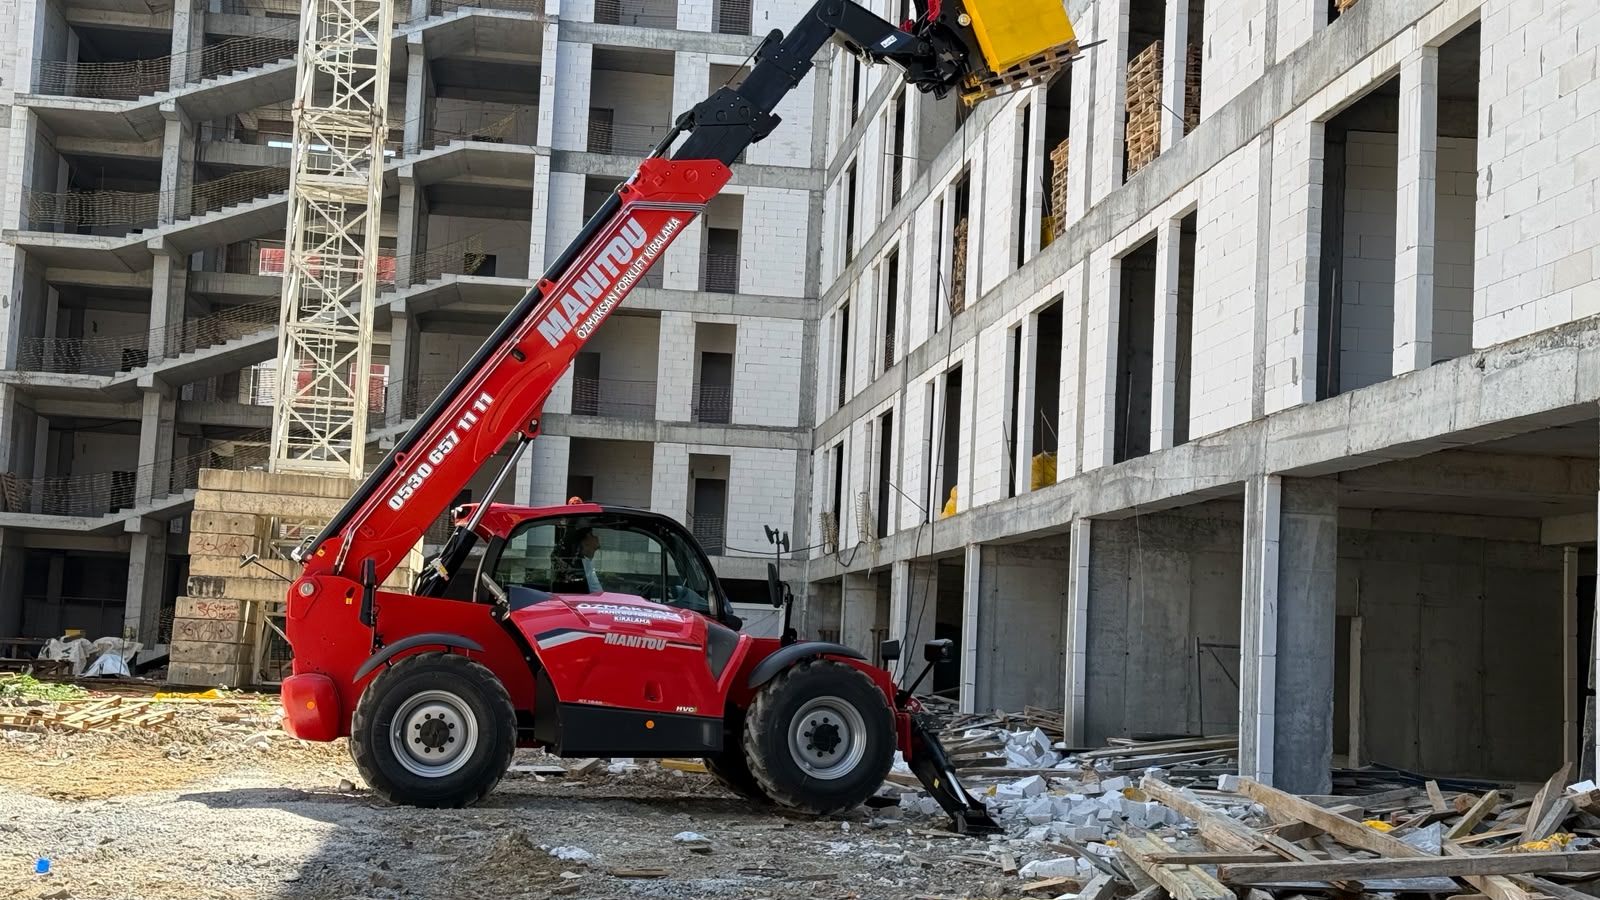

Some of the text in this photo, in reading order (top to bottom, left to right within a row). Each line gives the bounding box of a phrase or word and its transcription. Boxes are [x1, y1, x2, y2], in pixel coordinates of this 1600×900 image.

[537, 217, 647, 348] MANITOU
[388, 392, 494, 511] 0530 657 11 11
[604, 633, 667, 651] MANITOU
